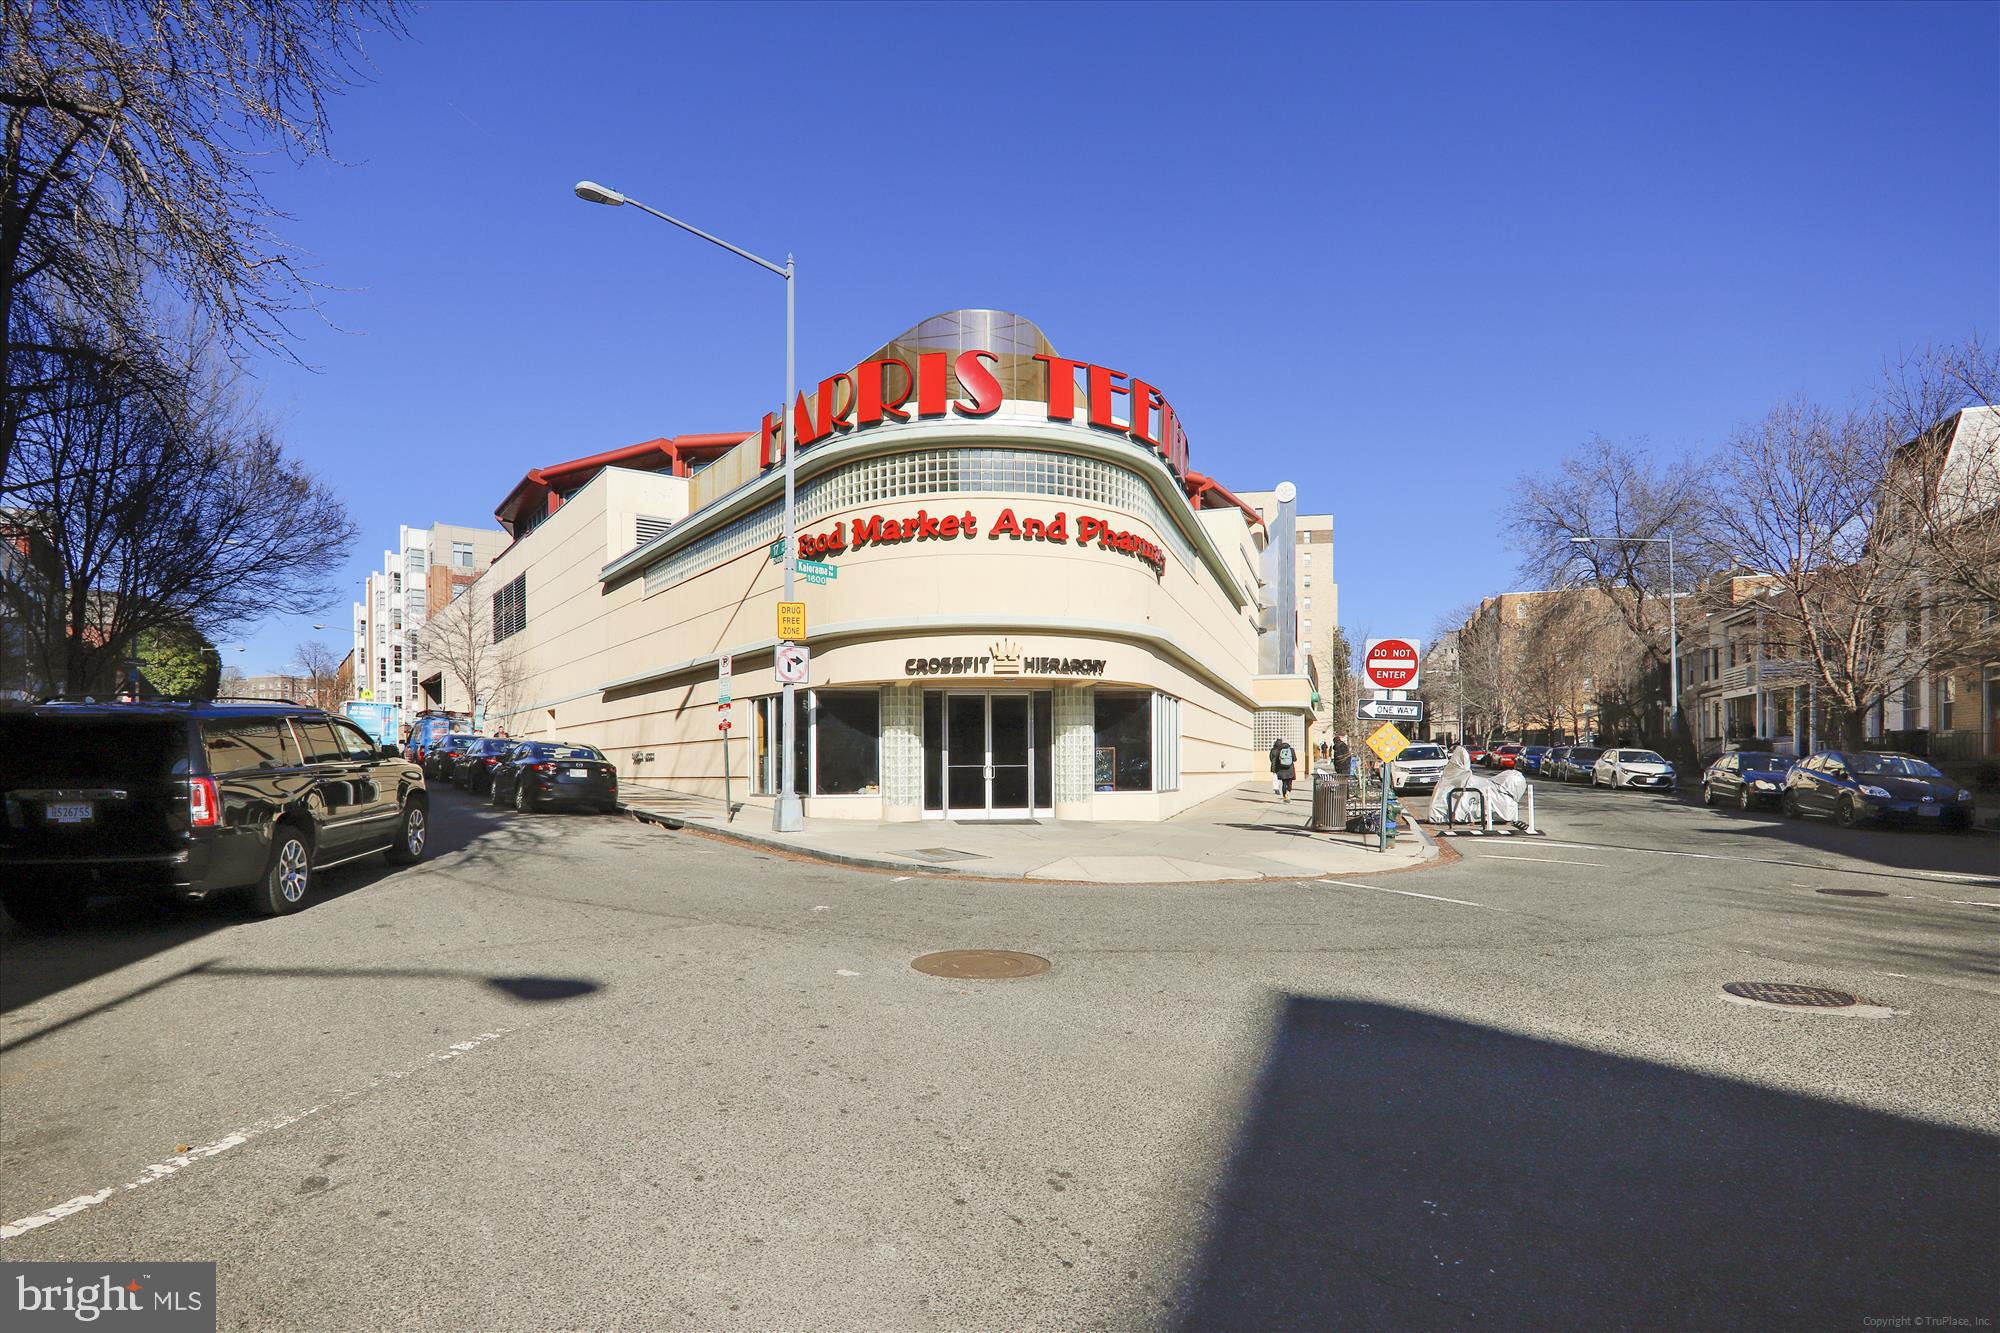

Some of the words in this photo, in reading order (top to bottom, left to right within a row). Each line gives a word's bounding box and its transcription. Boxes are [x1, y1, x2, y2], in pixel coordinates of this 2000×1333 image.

[760, 349, 1003, 470] HARRIS
[798, 521, 847, 560] Food
[852, 510, 978, 546] Market
[989, 508, 1069, 542] And
[798, 561, 828, 576] Kalorama
[808, 575, 826, 584] 1600
[781, 606, 801, 614] DRUG
[782, 617, 801, 625] FREE
[783, 627, 800, 635] ZONE
[1374, 649, 1387, 657] DO
[1392, 649, 1411, 657] NOT
[904, 656, 990, 676] CROSSFIT
[1023, 657, 1106, 677] HIERARCHY
[1376, 671, 1406, 679] ENTER
[1376, 705, 1394, 713] ONE
[1396, 706, 1415, 714] WAY
